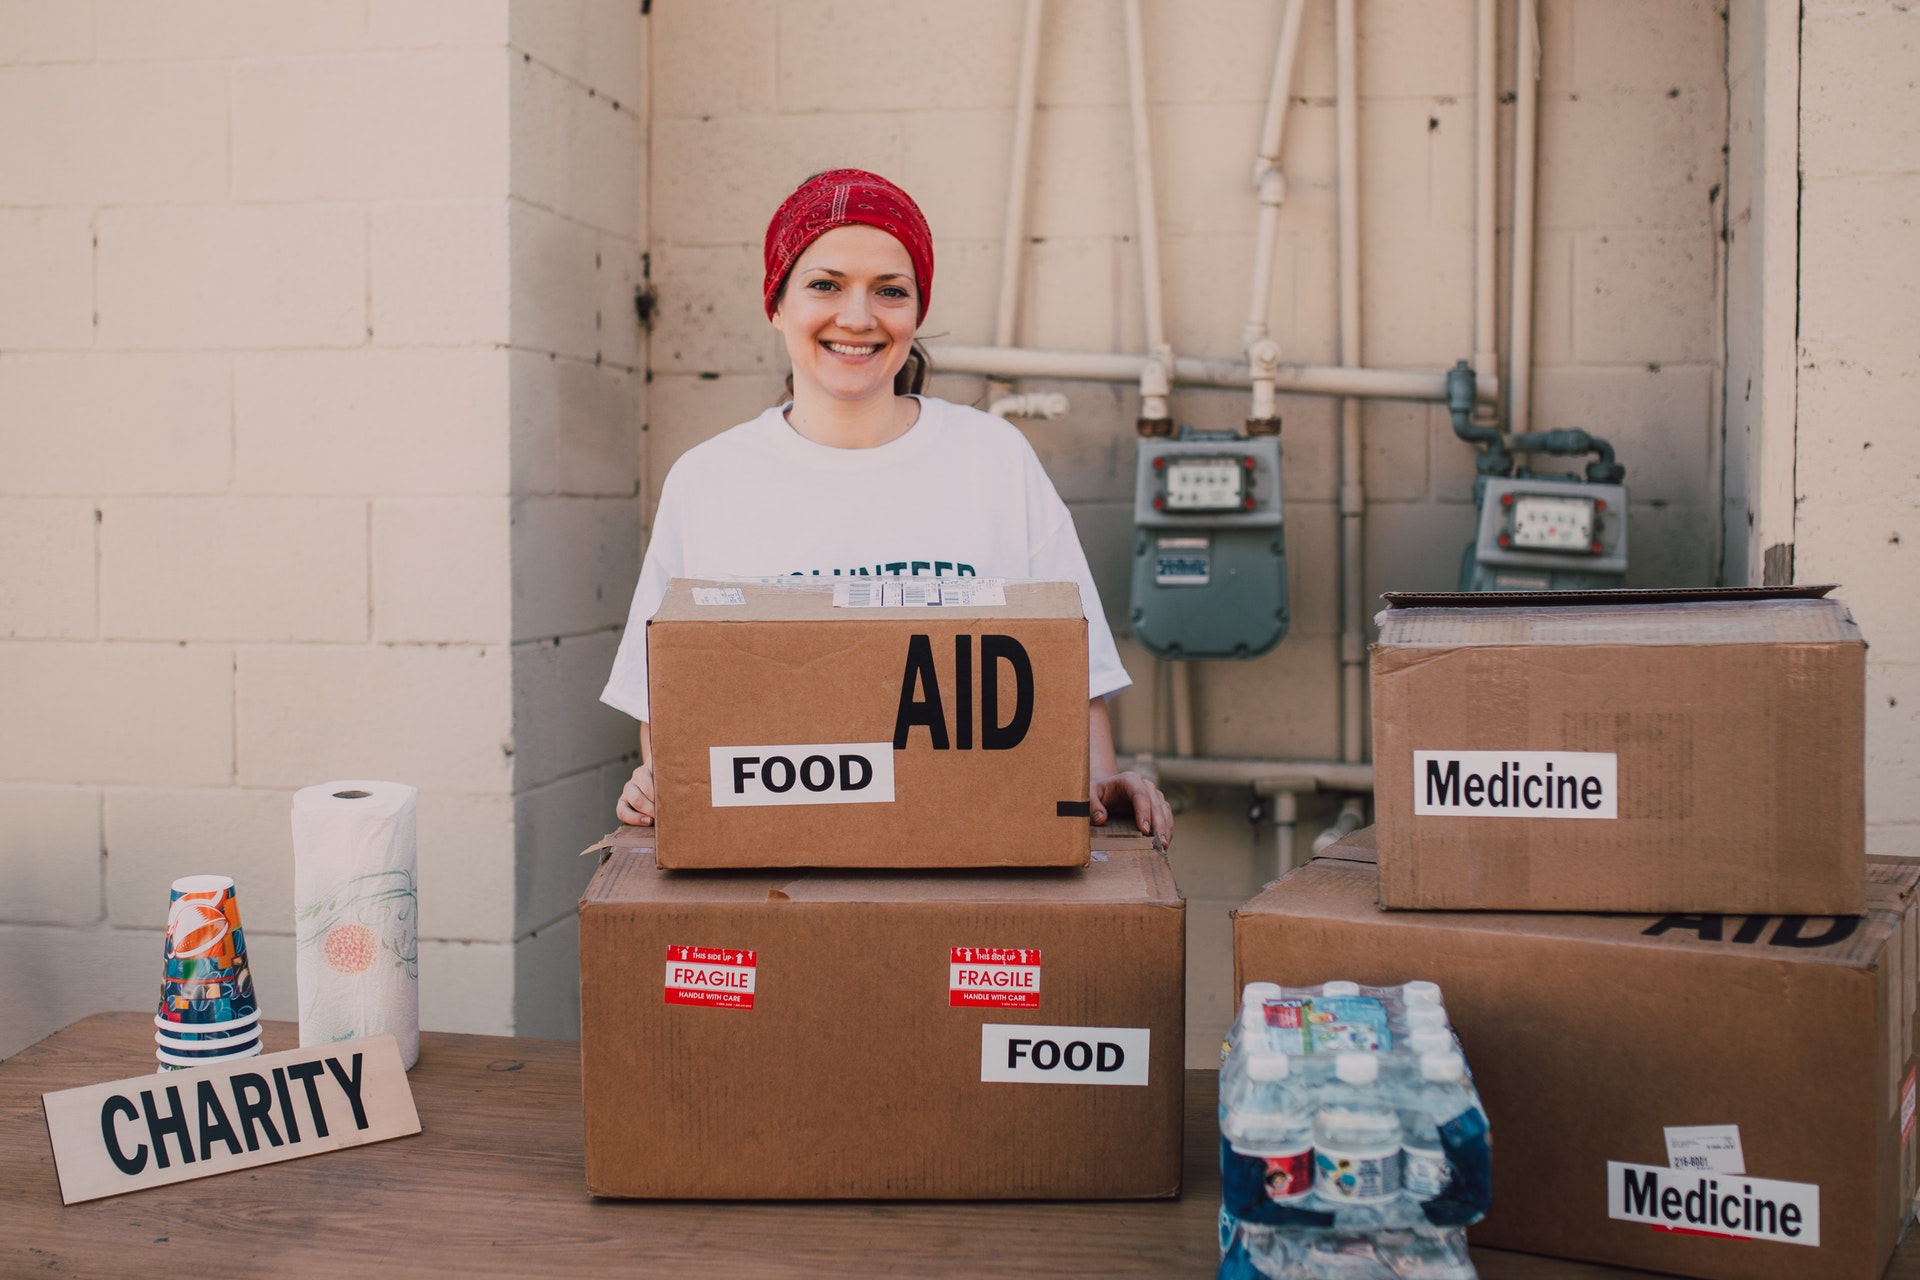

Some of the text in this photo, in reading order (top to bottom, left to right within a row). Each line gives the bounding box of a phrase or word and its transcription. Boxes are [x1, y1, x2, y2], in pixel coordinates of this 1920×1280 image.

[893, 634, 1034, 750] AID
[732, 754, 873, 793] FOOD
[1426, 760, 1602, 809] Medicine
[692, 952, 706, 960] THIS
[991, 953, 1006, 961] SIDE
[674, 968, 749, 988] FRAGILE
[958, 970, 1033, 987] FRAGILE
[679, 991, 741, 1002] HANDLE WITH CARE
[963, 993, 989, 1001] HANDLE
[1008, 994, 1026, 1002] CARE
[1008, 1039, 1125, 1072] FOOD
[101, 1052, 369, 1175] CHARITY
[1624, 1168, 1803, 1237] Medicine
